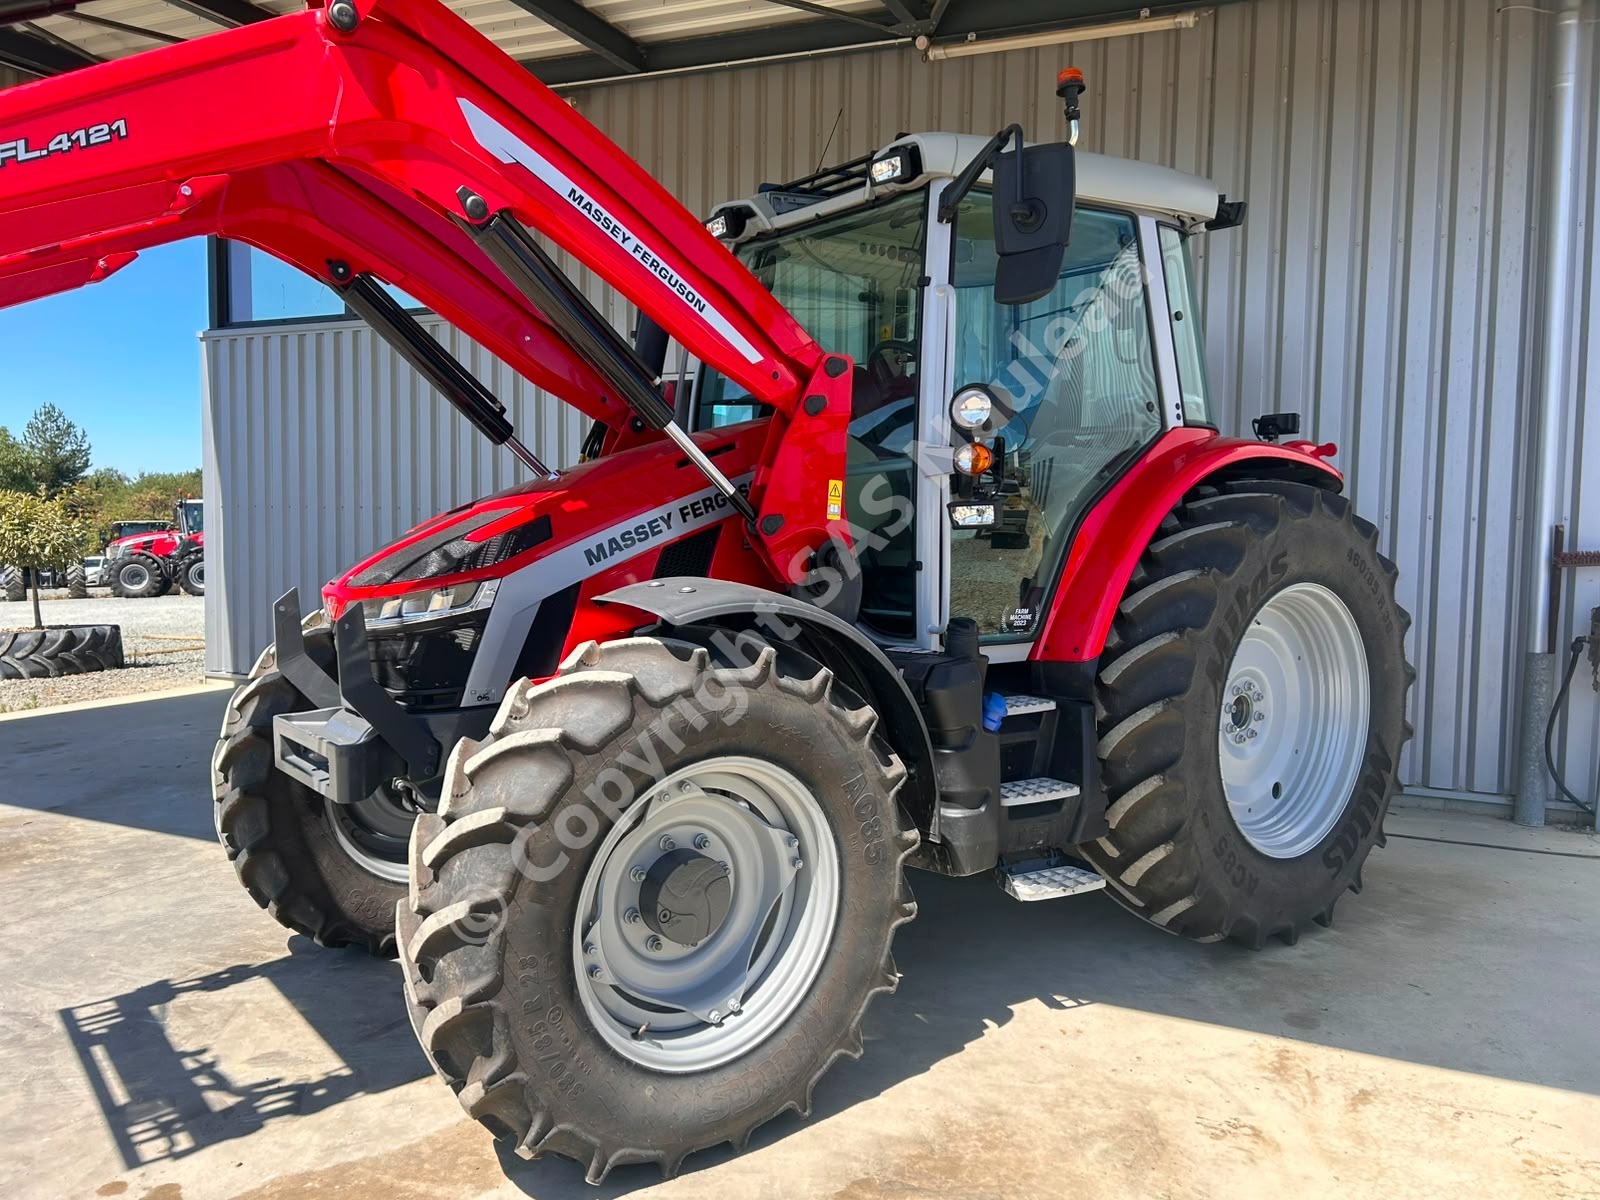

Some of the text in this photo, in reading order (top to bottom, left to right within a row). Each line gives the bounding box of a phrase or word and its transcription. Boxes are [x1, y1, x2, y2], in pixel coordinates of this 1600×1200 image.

[567, 187, 707, 314] MASSEY FERGUSON
[583, 511, 673, 567] MASSEY
[841, 770, 884, 865] AC85
[1212, 836, 1259, 897] AC85
[518, 955, 540, 988] 28
[522, 994, 544, 1016] R
[527, 1020, 585, 1100] 380/85
